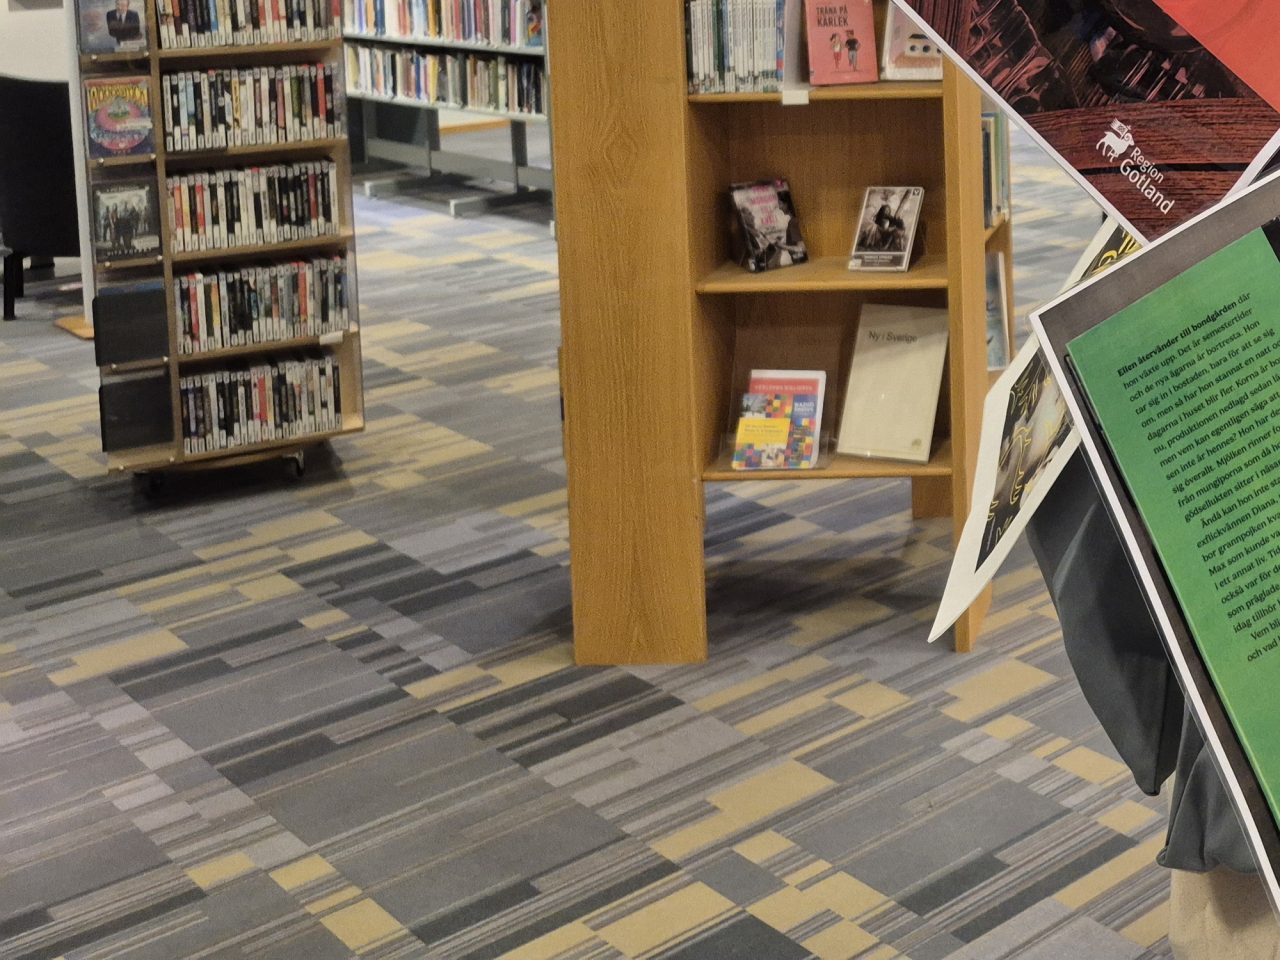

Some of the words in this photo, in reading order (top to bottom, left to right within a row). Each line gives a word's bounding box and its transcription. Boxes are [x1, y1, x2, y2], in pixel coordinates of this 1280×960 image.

[1129, 146, 1164, 184] Region
[1120, 158, 1175, 215] Gotland
[869, 330, 881, 340] Ny
[887, 332, 918, 344] Sverige
[1116, 361, 1138, 377] Ellen
[1137, 335, 1179, 365] återvänder
[1179, 326, 1192, 339] till
[1190, 301, 1237, 332] bondgården
[1237, 292, 1250, 304] där
[1247, 648, 1263, 662] och
[1262, 637, 1278, 652] vad
